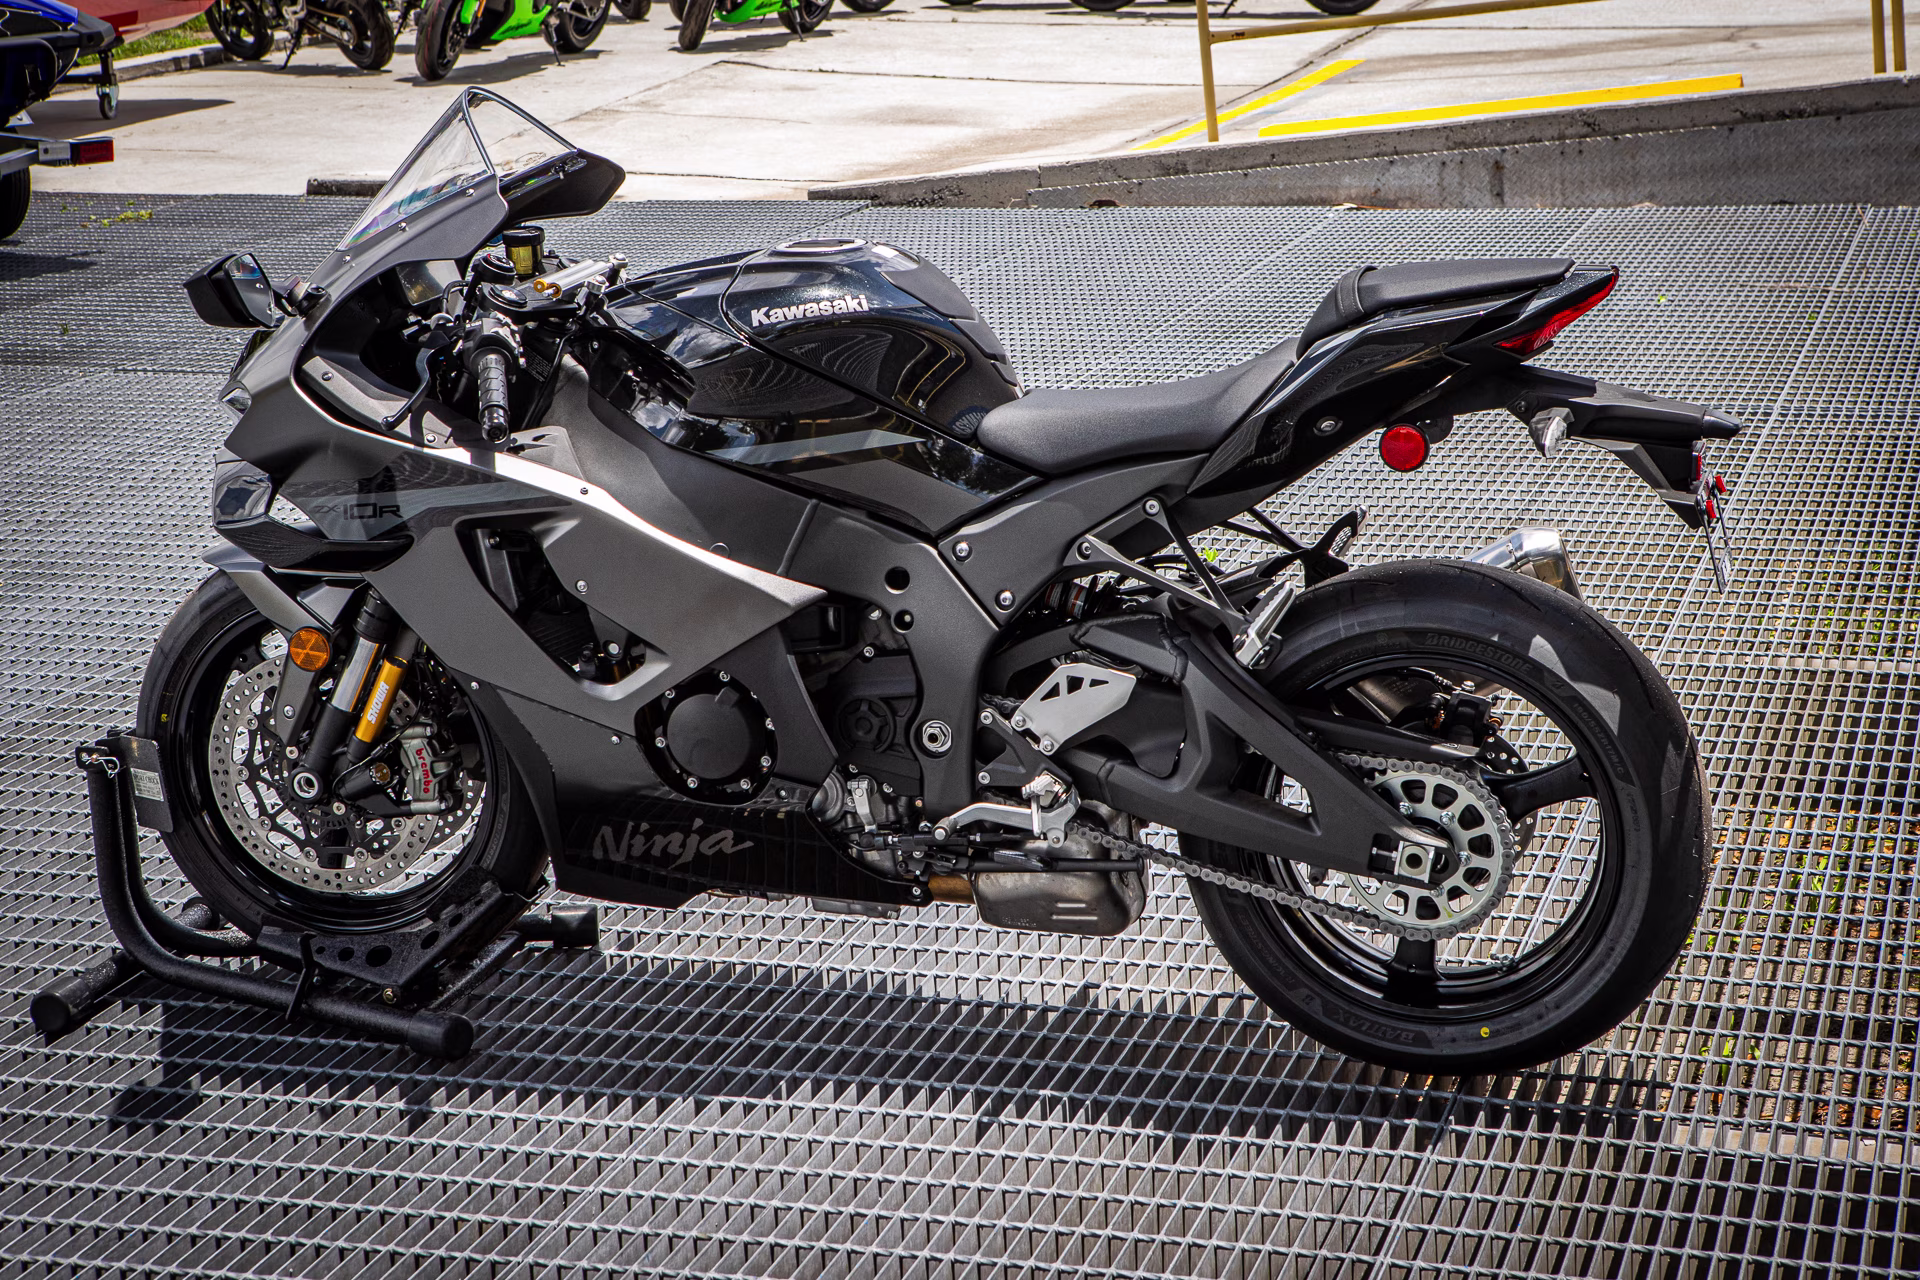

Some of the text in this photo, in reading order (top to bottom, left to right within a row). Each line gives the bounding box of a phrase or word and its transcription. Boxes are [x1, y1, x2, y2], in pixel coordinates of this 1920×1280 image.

[751, 294, 870, 327] Kawasaki
[312, 502, 404, 521] ZX-10R
[1424, 632, 1535, 674] BRIDGESTONE
[367, 681, 390, 725] SHOWA
[415, 747, 434, 794] brembo
[592, 817, 755, 869] Ninja
[1331, 1007, 1417, 1044] BATTLAX
